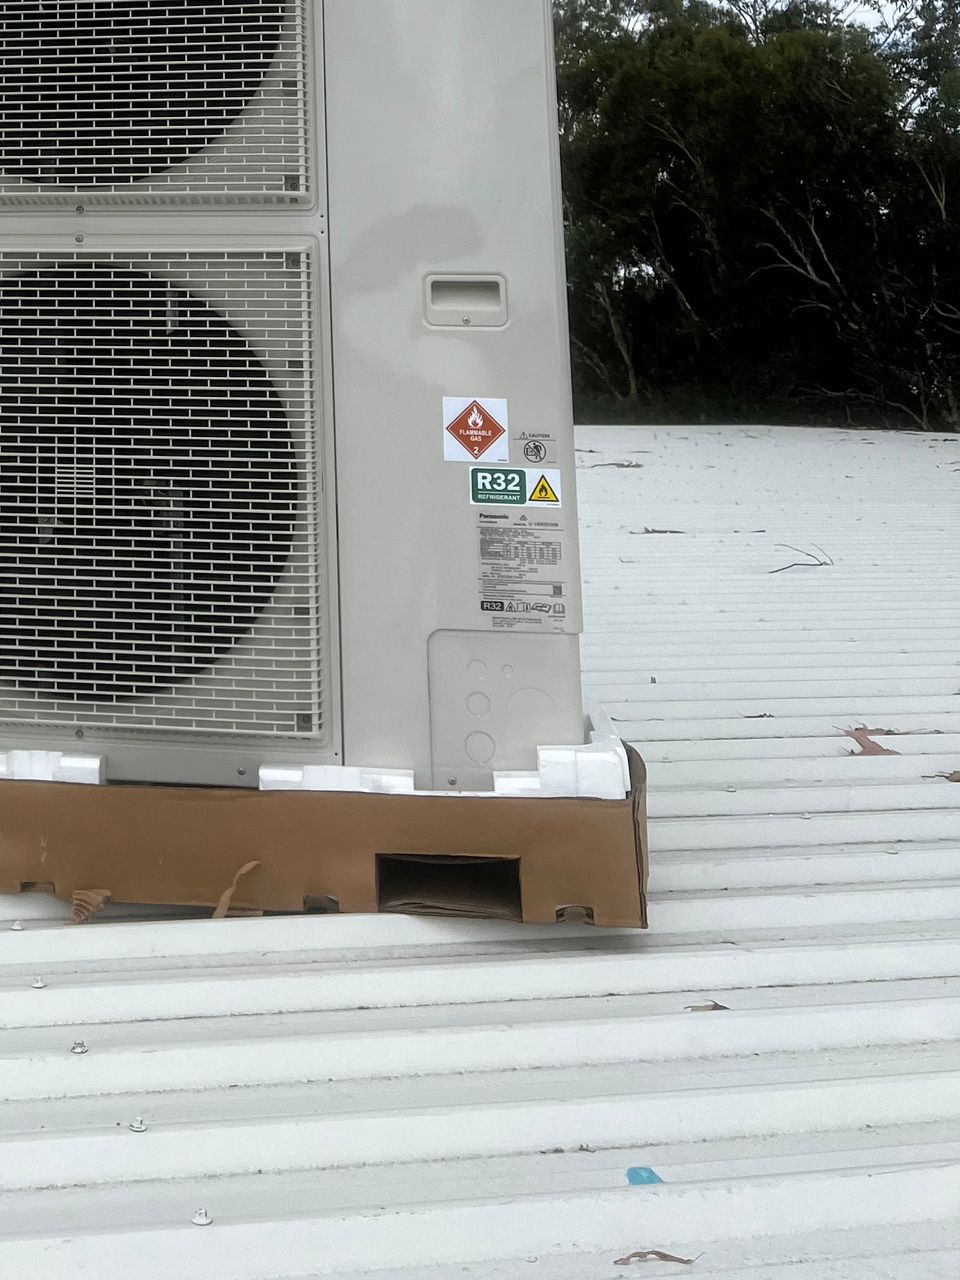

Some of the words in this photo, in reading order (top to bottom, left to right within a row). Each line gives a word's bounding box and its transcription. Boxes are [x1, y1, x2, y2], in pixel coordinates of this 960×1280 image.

[459, 429, 492, 437] FLAMMABLE
[473, 446, 479, 454] 2
[477, 472, 520, 491] R32
[477, 493, 521, 501] REFRIGERANT
[483, 602, 502, 610] R32
